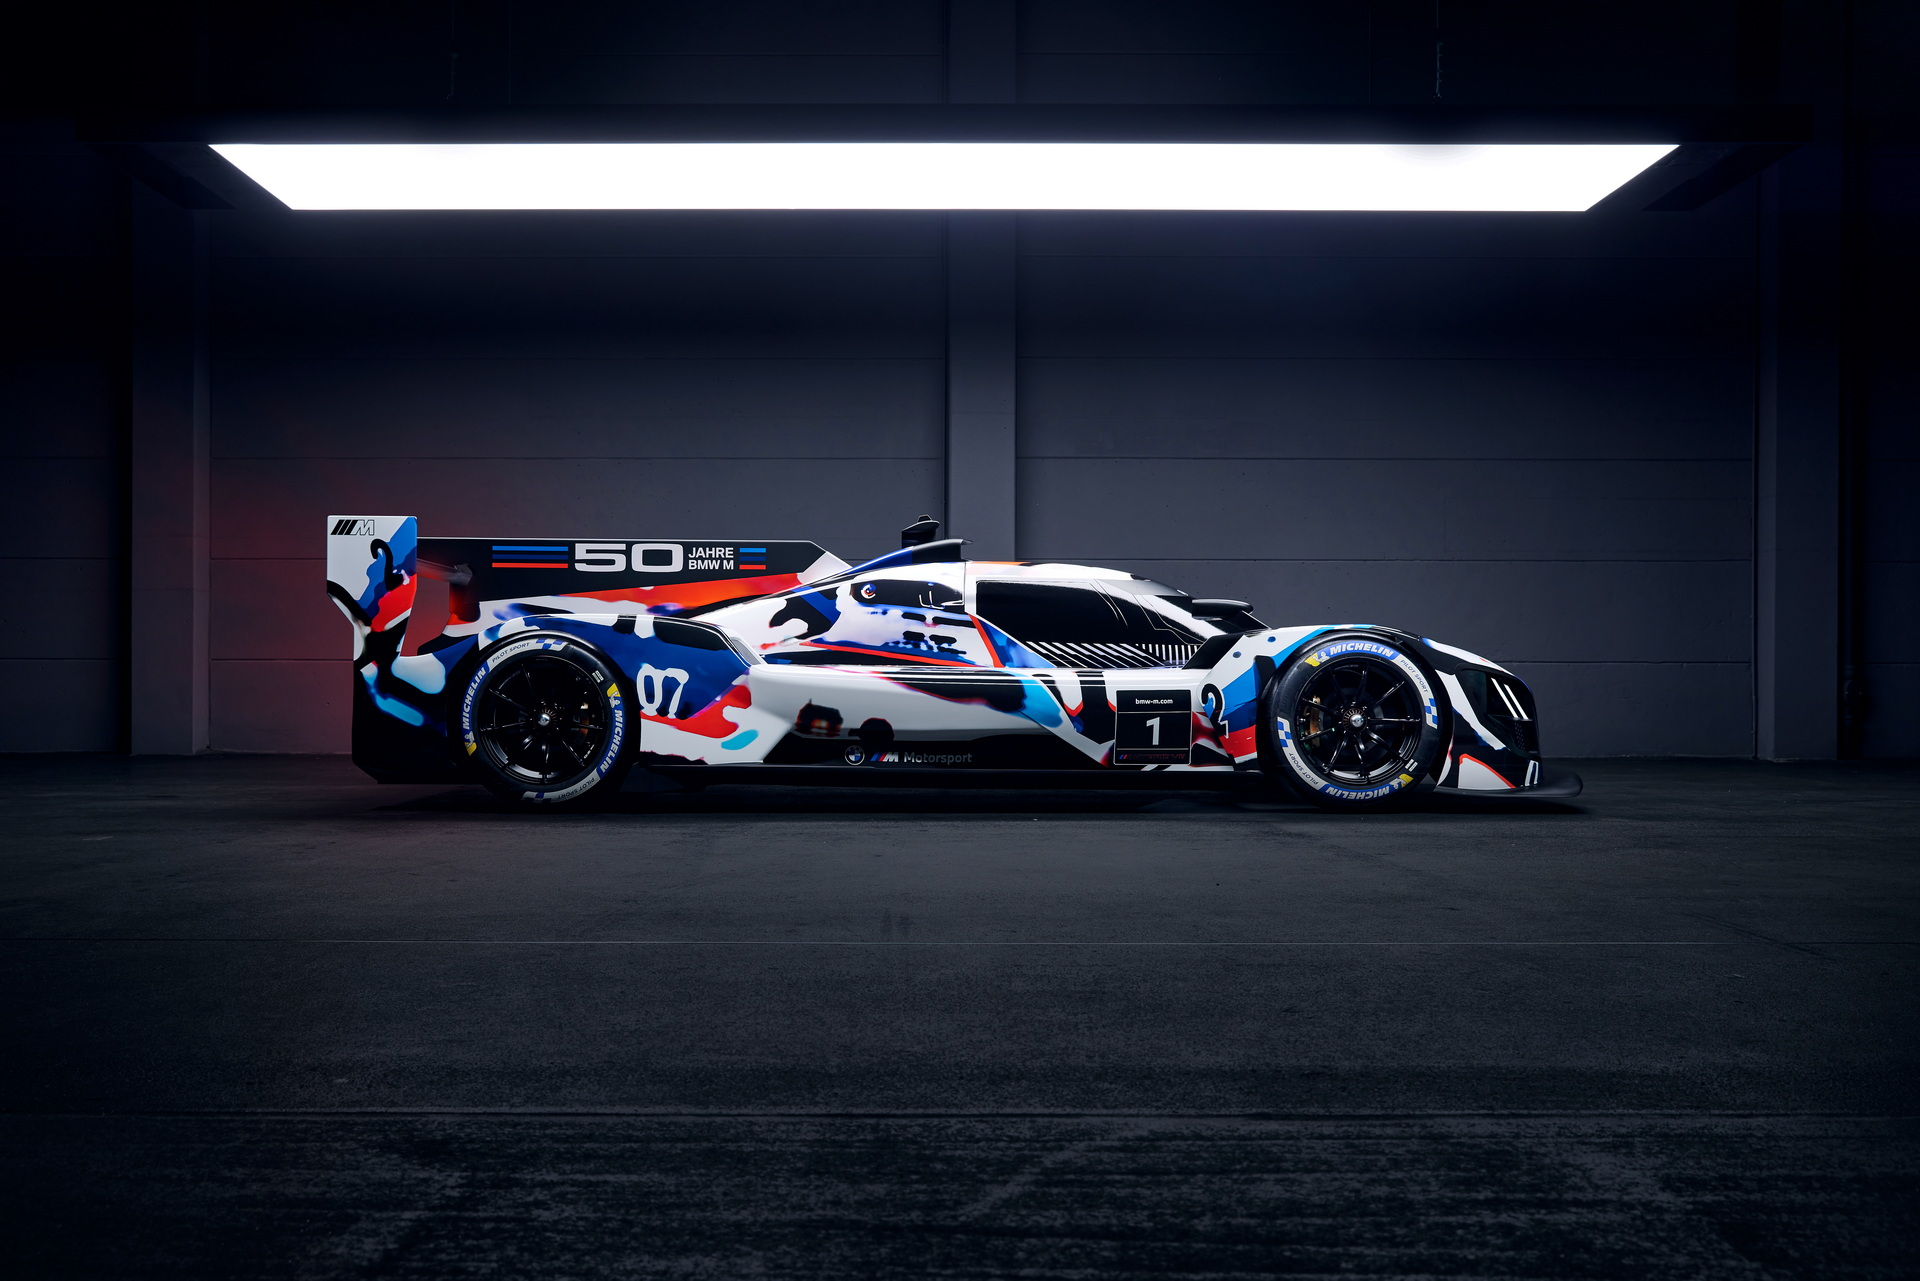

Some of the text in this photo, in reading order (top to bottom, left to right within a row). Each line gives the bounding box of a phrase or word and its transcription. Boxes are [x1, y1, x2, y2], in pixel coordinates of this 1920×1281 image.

[575, 543, 684, 573] 50
[688, 547, 734, 558] JAHRE
[688, 559, 734, 570] BMW M
[491, 642, 530, 663] PILOT SPORT
[1330, 642, 1394, 657] MICHELIN
[1400, 659, 1428, 693] PILOT SPORT
[462, 666, 487, 730] MICHELIN
[600, 709, 624, 773] MICHELIN
[1146, 716, 1160, 746] 1
[903, 751, 973, 765] Motorsport
[1288, 752, 1319, 786] PILOT SPORT
[557, 777, 595, 800] PILOT SPORT
[1325, 785, 1390, 800] MICHELIN
